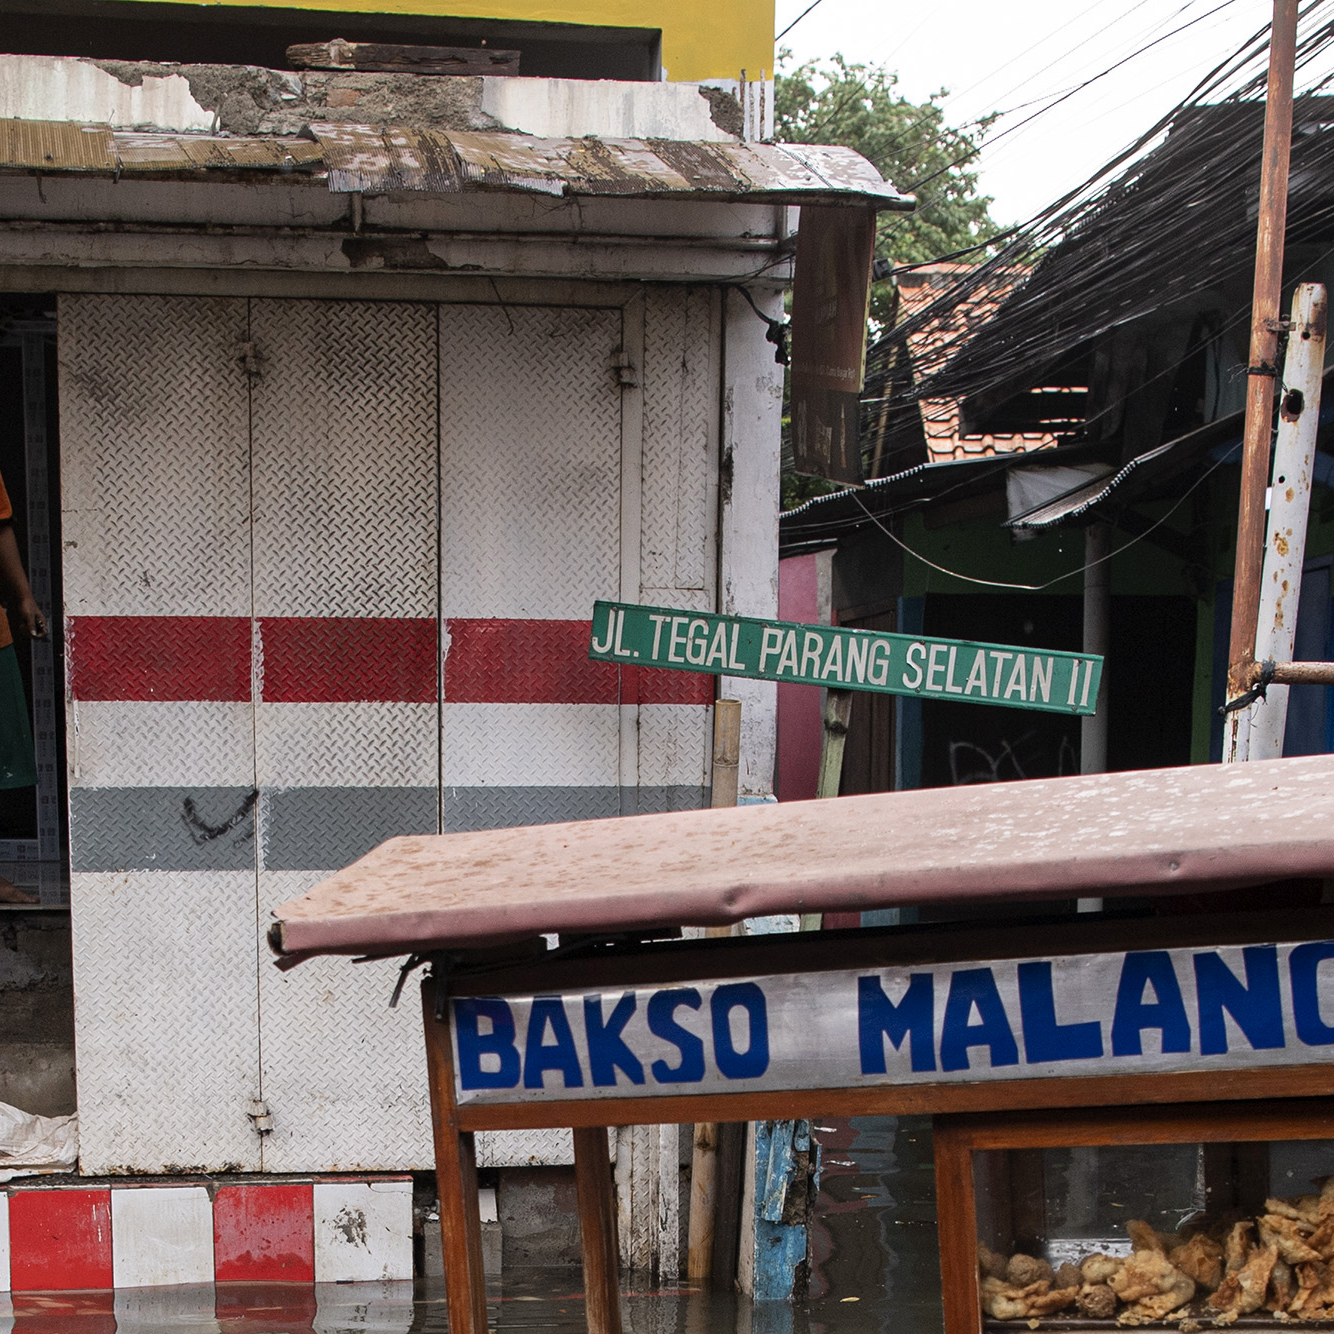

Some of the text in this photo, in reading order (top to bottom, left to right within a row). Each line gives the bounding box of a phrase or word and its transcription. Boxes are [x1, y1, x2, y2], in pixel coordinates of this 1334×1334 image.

[592, 608, 1095, 707] JL. TEGAL PARANG SELATAN II
[454, 981, 770, 1090] BAKSO
